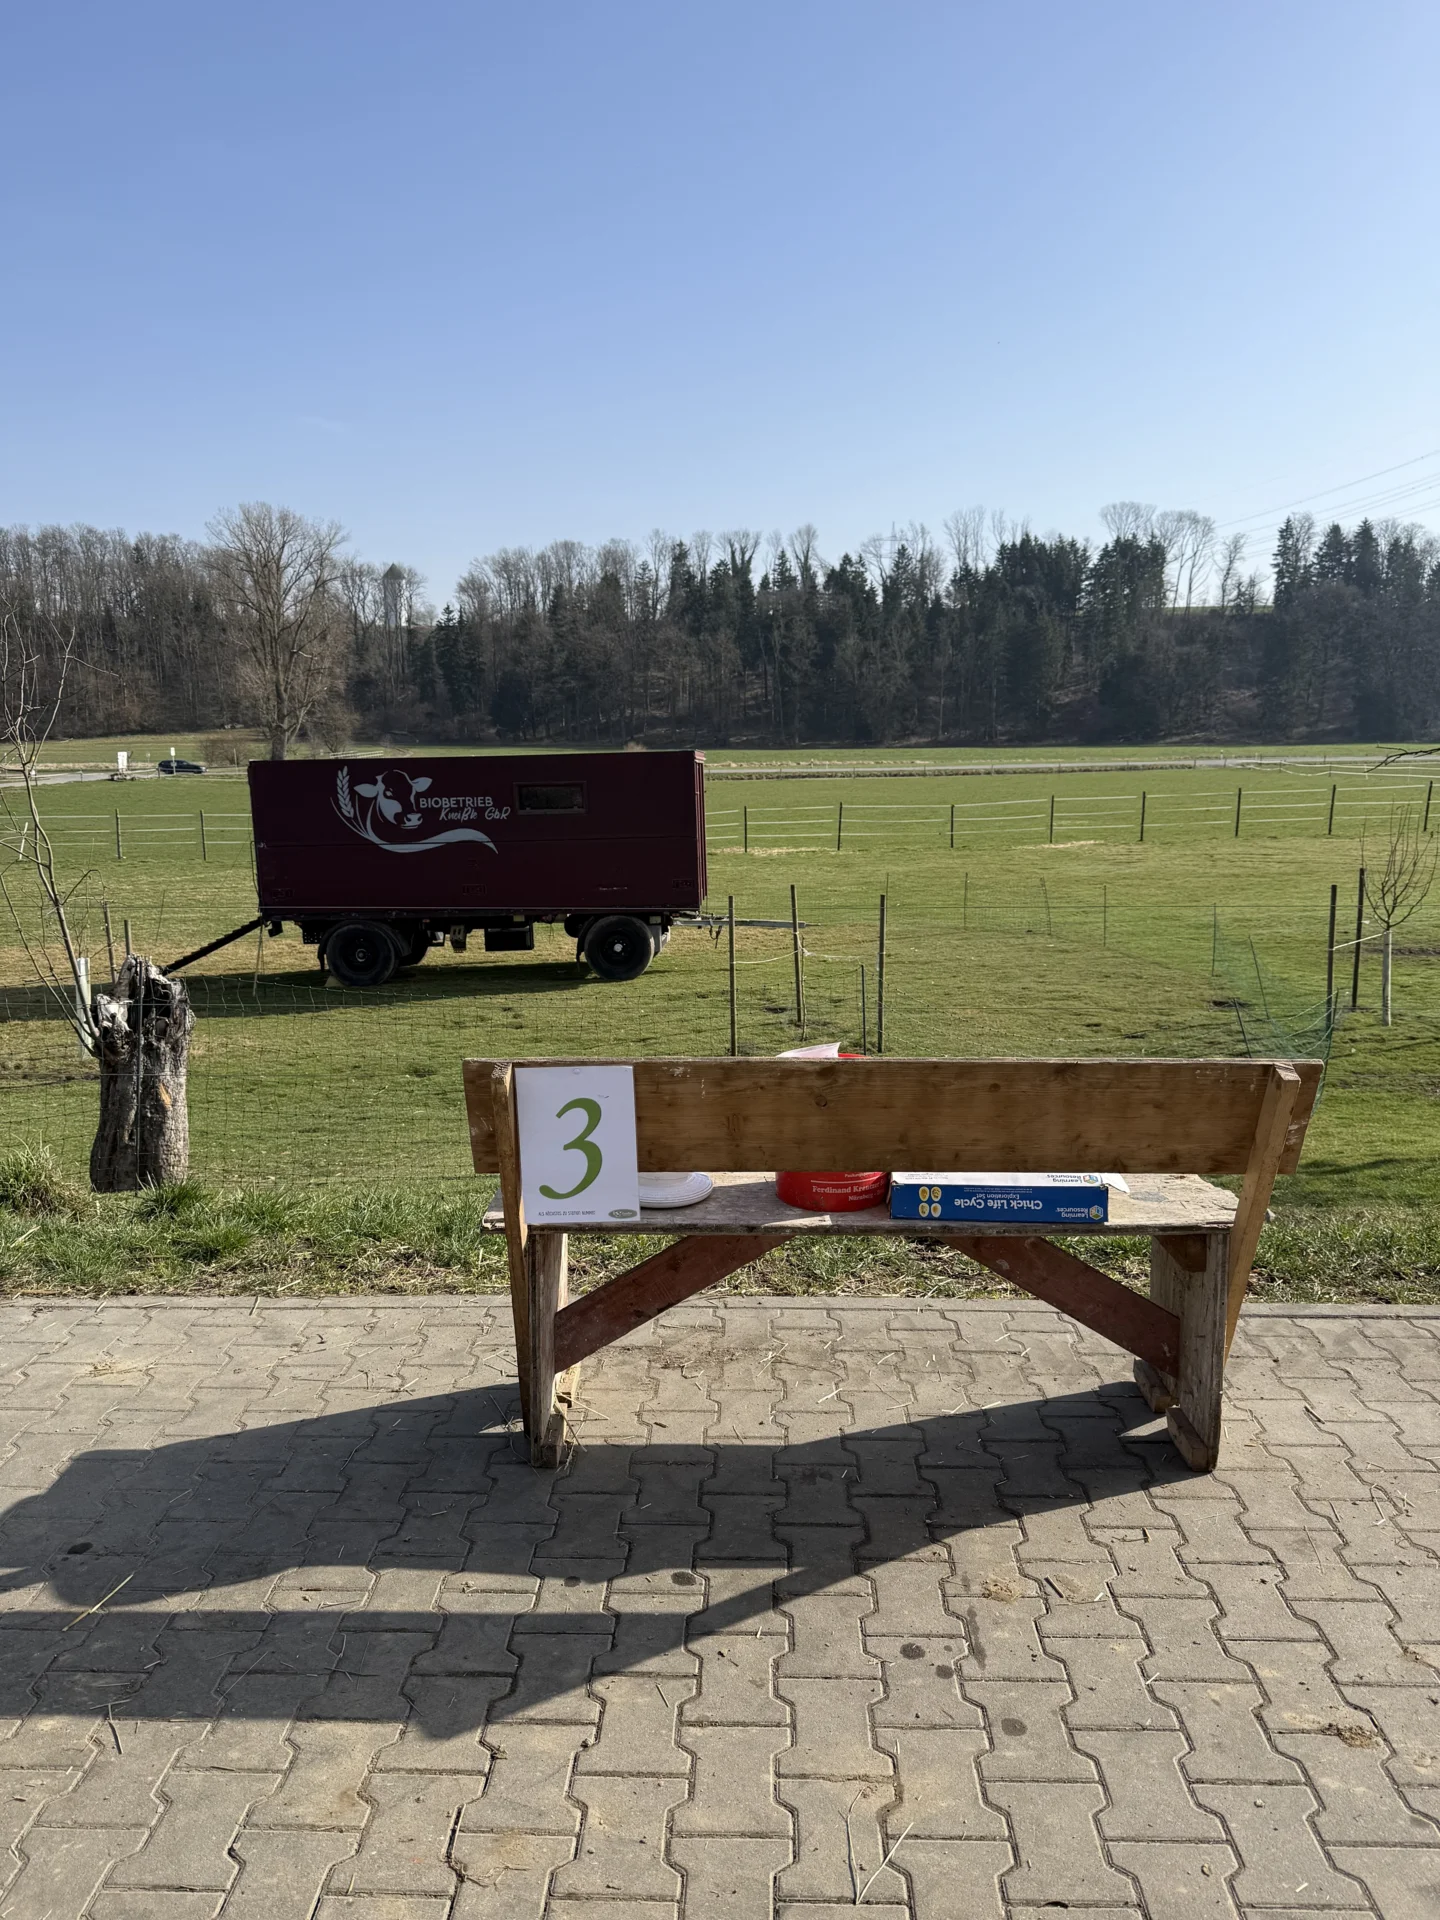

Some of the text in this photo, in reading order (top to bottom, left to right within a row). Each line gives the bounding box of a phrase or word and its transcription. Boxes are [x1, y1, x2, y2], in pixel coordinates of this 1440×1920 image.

[420, 797, 493, 808] BIOBETRIEB
[484, 807, 511, 820] GbR
[538, 1097, 603, 1200] 3
[812, 1185, 852, 1194] Ferdinand
[954, 1197, 1043, 1210] Chick Life Cycle
[1061, 1211, 1089, 1219] Learning
